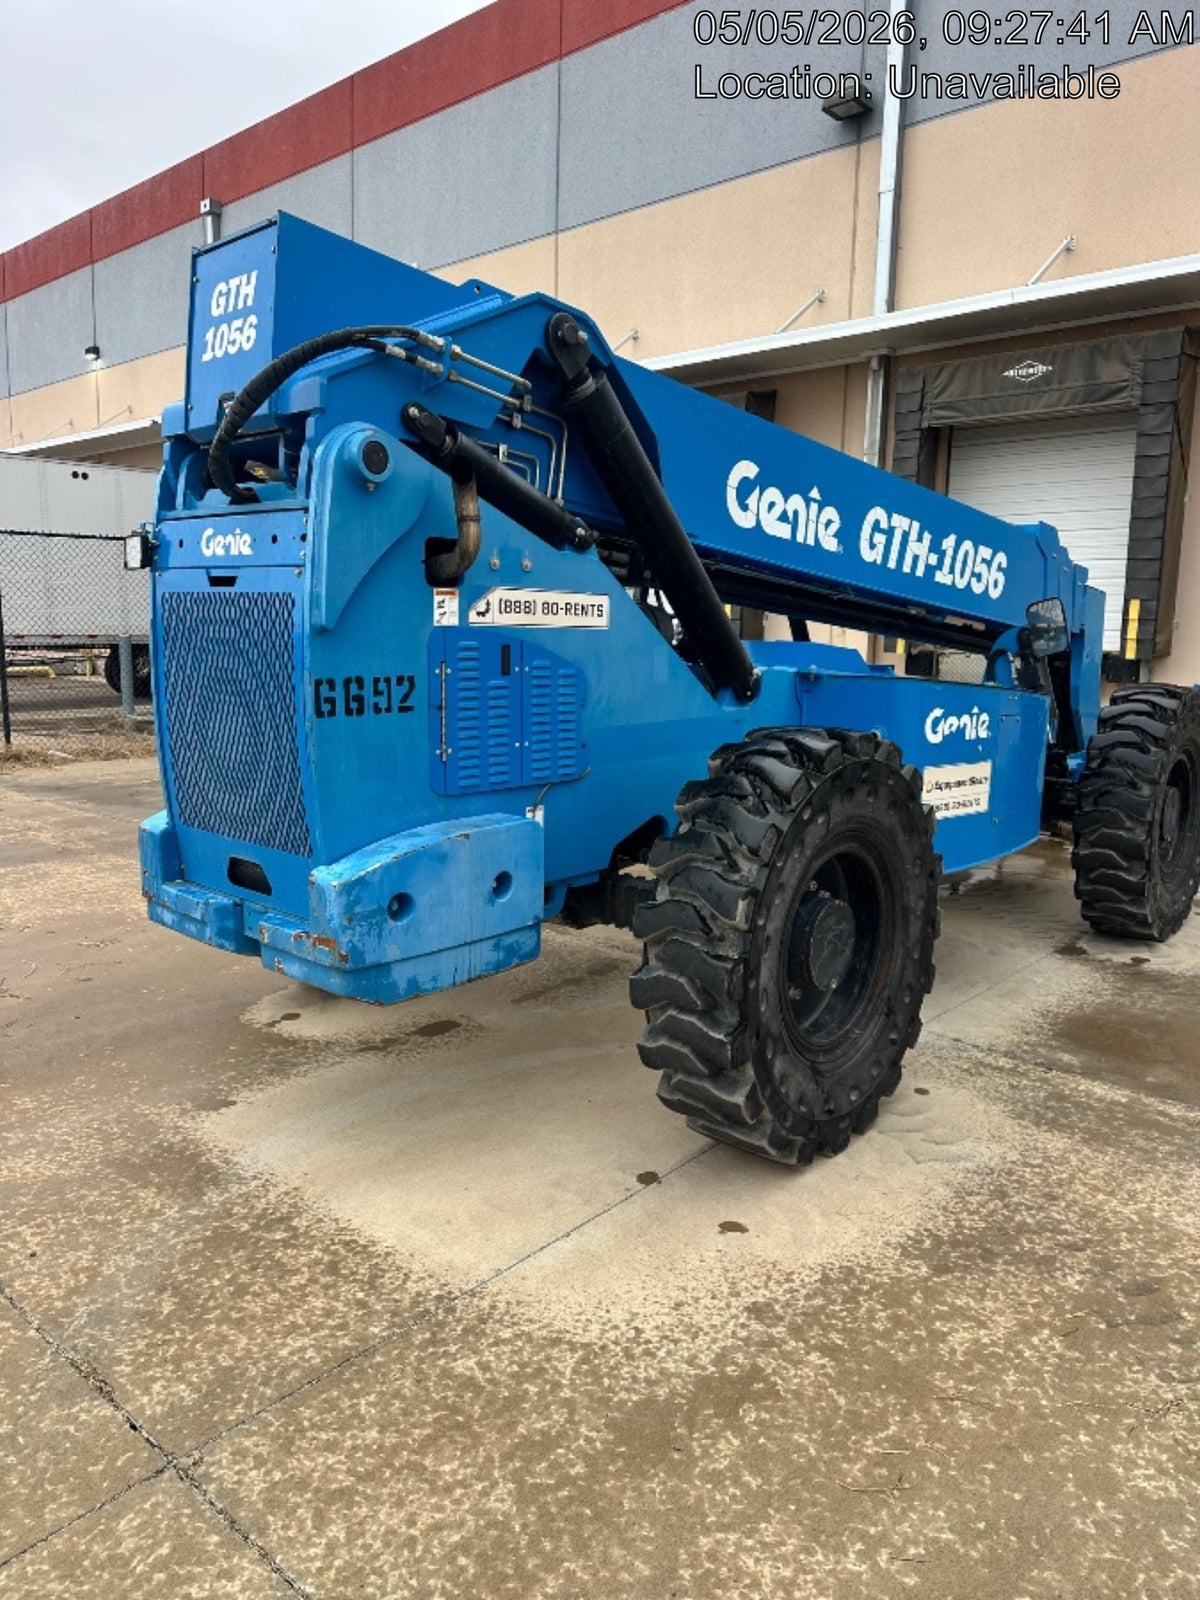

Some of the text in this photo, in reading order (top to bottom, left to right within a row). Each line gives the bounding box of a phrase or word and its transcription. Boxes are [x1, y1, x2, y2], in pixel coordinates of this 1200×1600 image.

[210, 270, 258, 317] GTH
[202, 314, 258, 362] 1056
[201, 527, 253, 557] Genie
[726, 459, 1008, 600] Genie GTH-1056
[499, 599, 604, 618] (888) 80-RENTS
